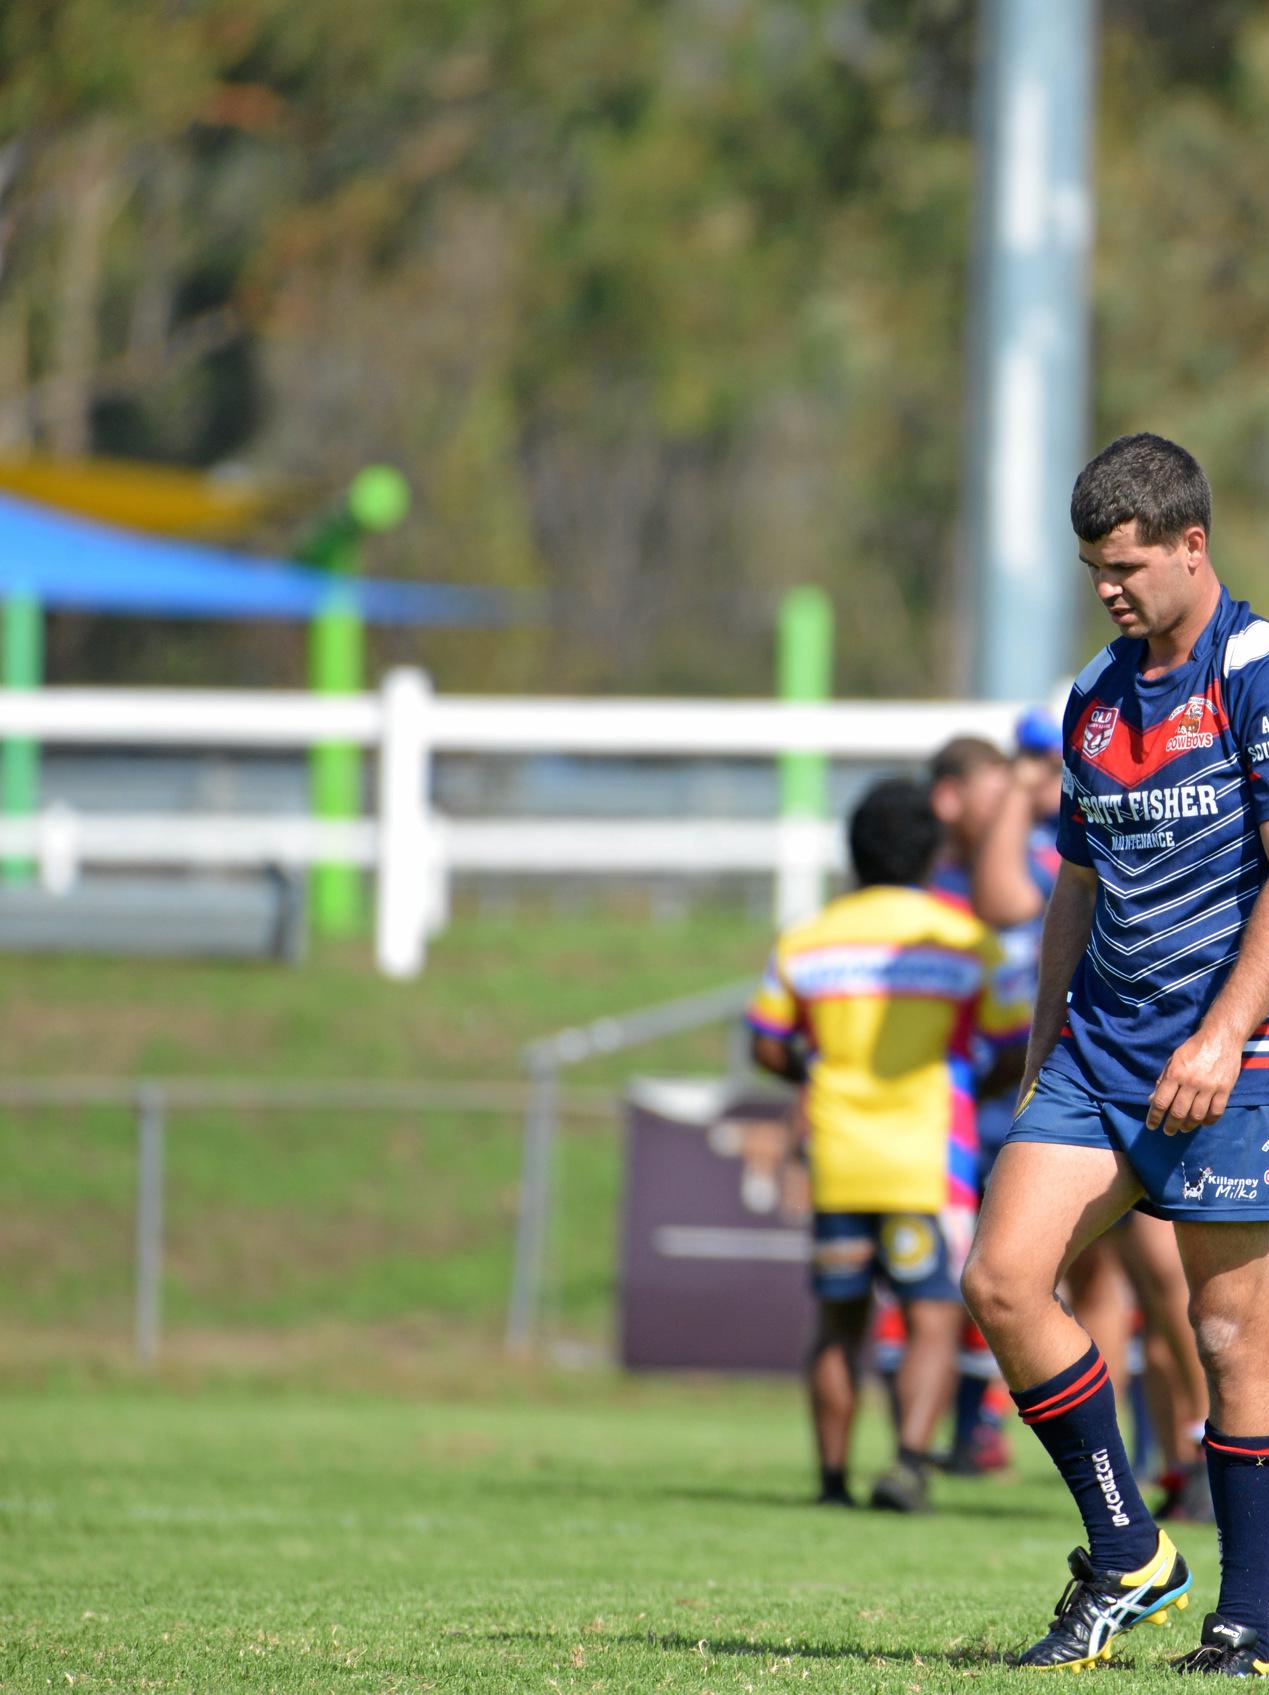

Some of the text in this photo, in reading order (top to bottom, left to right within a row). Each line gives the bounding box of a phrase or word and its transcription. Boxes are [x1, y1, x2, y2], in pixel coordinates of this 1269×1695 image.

[1091, 710, 1112, 723] QLD
[1166, 733, 1213, 751] COWBOYS
[1128, 784, 1219, 822] FISHER
[1112, 831, 1176, 851] MAINTENANCE
[1208, 1175, 1259, 1188] Killarney
[1215, 1180, 1258, 1200] Milko
[1091, 1448, 1130, 1527] COWBOYS
